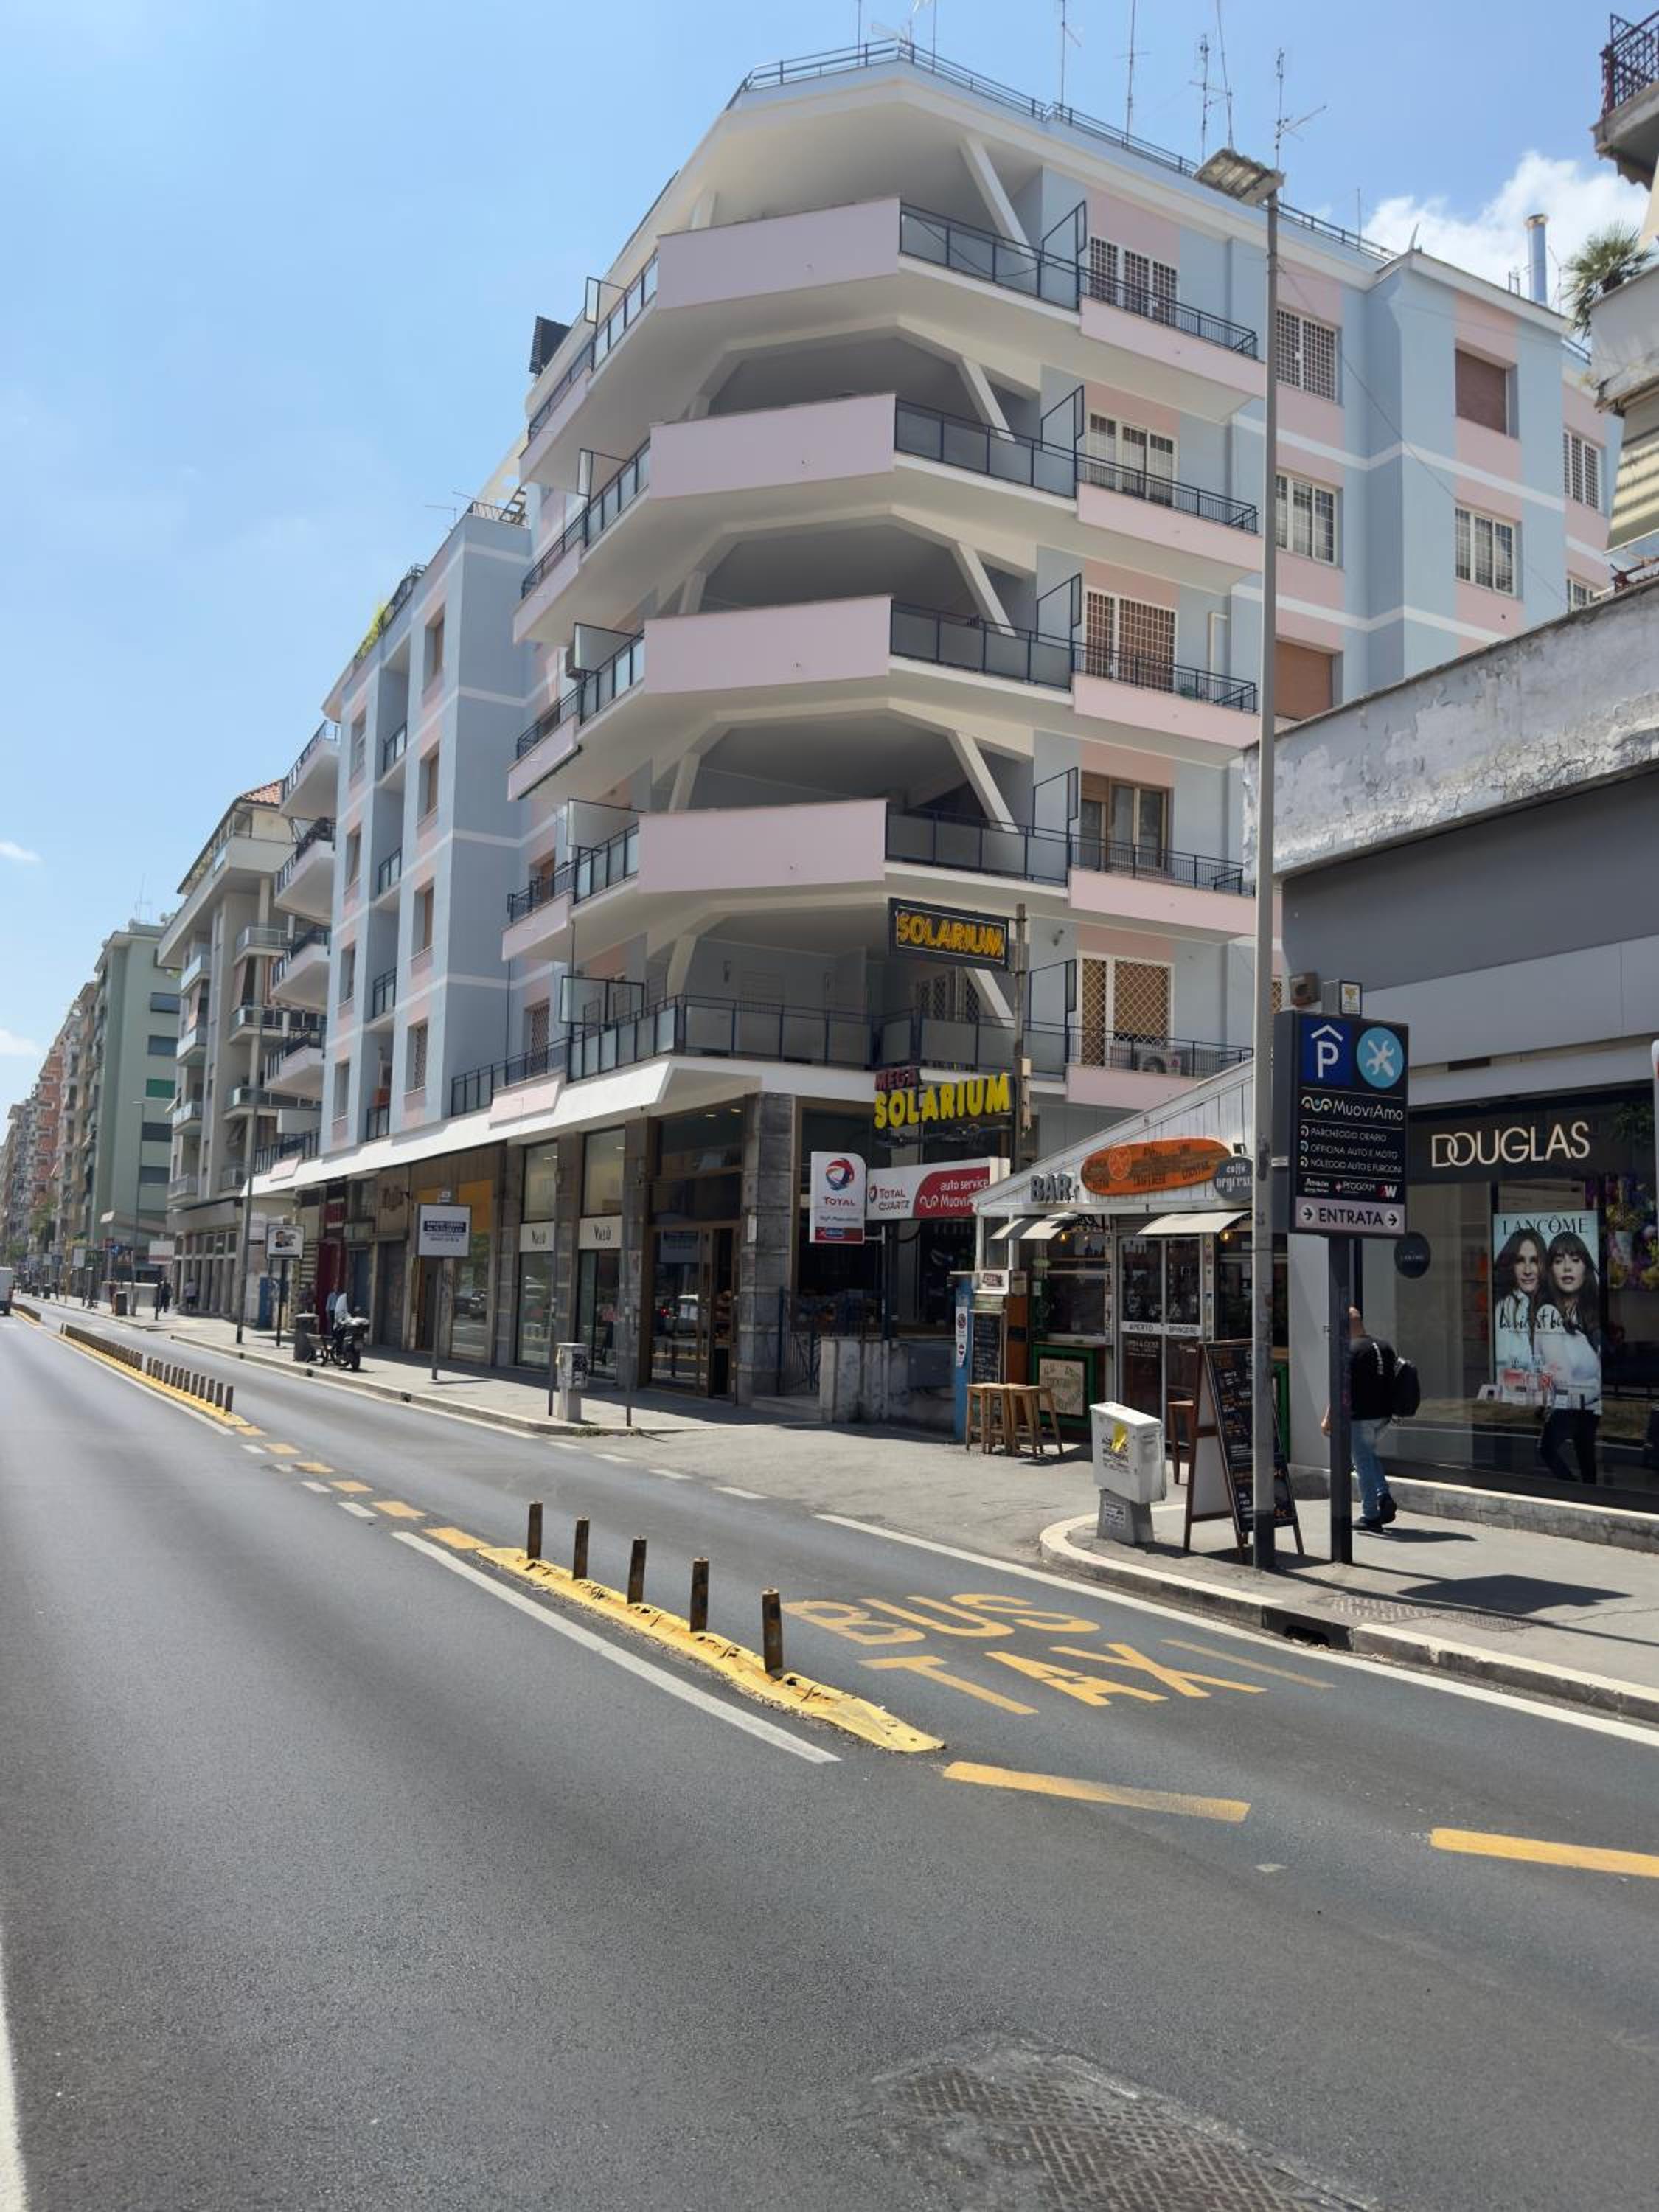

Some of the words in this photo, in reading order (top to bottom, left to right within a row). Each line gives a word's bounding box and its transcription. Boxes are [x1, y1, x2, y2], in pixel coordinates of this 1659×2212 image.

[897, 912, 1004, 956] SOLARIUM
[1318, 1040, 1339, 1079] P
[874, 1068, 917, 1091] MEGA
[874, 1072, 1010, 1130] SOLARIUM
[1431, 1121, 1590, 1168] DOUGLAS
[878, 1188, 906, 1199] TOTAL
[940, 1180, 959, 1191] auto
[960, 1177, 991, 1189] service
[1031, 1174, 1073, 1203] BAR
[824, 1197, 855, 1206] TOTAL
[878, 1200, 910, 1211] QUARTZ
[1318, 1208, 1384, 1225] ENTRATA
[783, 1593, 1099, 1645] BUS
[858, 1638, 1336, 1714] TAXI
